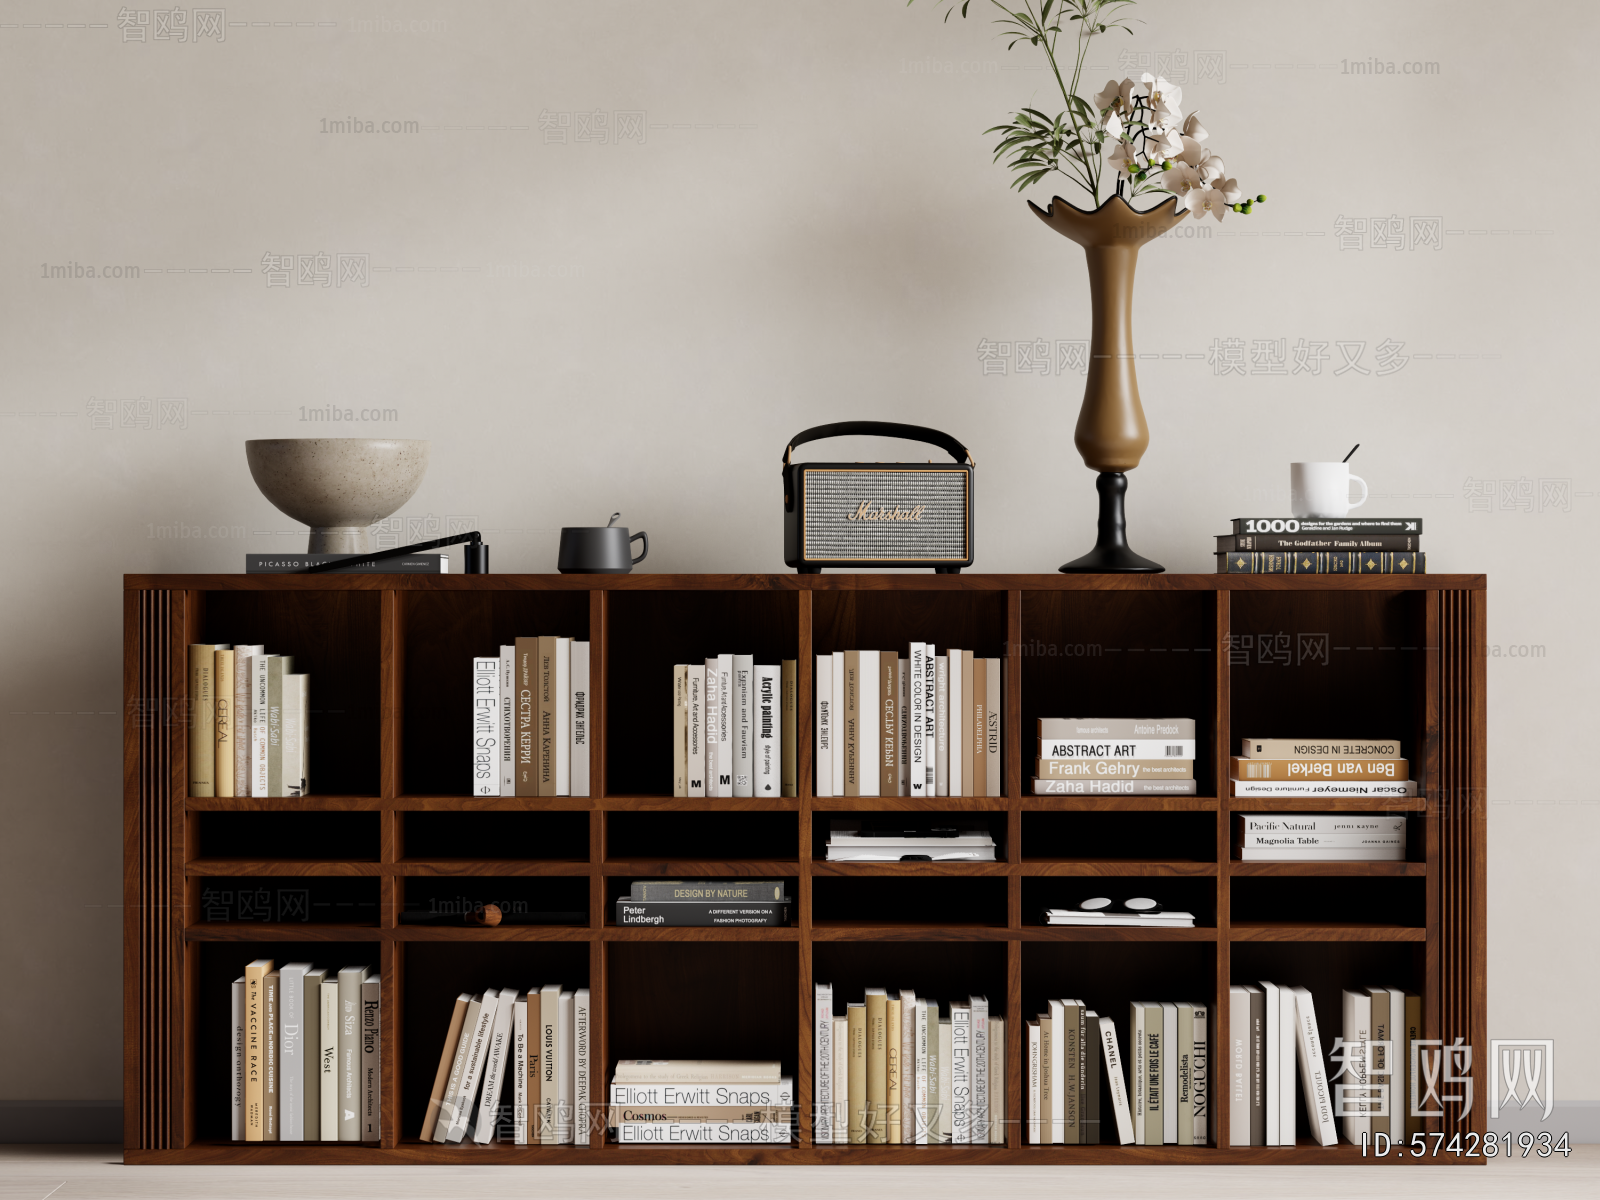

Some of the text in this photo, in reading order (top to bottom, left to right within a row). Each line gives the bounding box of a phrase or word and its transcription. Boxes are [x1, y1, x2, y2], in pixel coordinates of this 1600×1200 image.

[848, 500, 926, 520] Marshall
[1246, 519, 1300, 533] 1000
[707, 668, 717, 744] Zaha Hadid
[926, 656, 934, 738] ABSTRACT ART
[761, 677, 773, 738] Acrylic painting
[218, 699, 228, 748] CEREAL
[270, 706, 280, 746] Wabi-Sabi
[474, 662, 496, 779] Elliott Erwitt Snaps
[520, 690, 531, 764] СЕСТРА КЕРРИ
[575, 692, 585, 744] ФРИДРИХ ЭНГЕЛЬС
[914, 713, 921, 722] IN
[1134, 725, 1179, 735] Antoine Predock
[1052, 745, 1136, 757] ABSTRACT ART
[1294, 746, 1394, 754] CONCRETE IN DESIGN
[1050, 761, 1091, 775] Frank
[1096, 761, 1140, 778] Gehry
[1288, 763, 1394, 776] Ben van Berkel
[720, 775, 730, 785] M
[1045, 780, 1134, 792] Zaha Hadid
[1250, 822, 1316, 831] Pacific Natural
[674, 889, 748, 898] DESIGN BY NATURE
[624, 916, 664, 925] Lindbergh
[345, 1016, 355, 1035] Siza
[364, 1000, 379, 1054] Renzo Piano
[284, 1024, 298, 1055] Dior
[469, 1038, 482, 1074] sustainable
[478, 1013, 489, 1038] lifestyle
[518, 1043, 524, 1053] Be
[1148, 1033, 1159, 1049] CAFÉ
[578, 1006, 586, 1100] AFTERWORD BY DEEPAK
[1105, 1031, 1116, 1069] CHANEL
[324, 1046, 334, 1074] West
[446, 1092, 454, 1106] THIS
[454, 1055, 464, 1075] GOOD
[460, 1033, 469, 1054] GUIDE
[530, 1054, 538, 1078] Paris
[952, 1012, 969, 1127] Elliott Erwitt Snaps
[1150, 1059, 1159, 1072] FOIS
[485, 1033, 503, 1107] DREAM AWAKE
[889, 1048, 897, 1096] CEREAL
[1150, 1074, 1159, 1085] UNE
[1180, 1054, 1188, 1103] Remodelista
[1194, 1041, 1206, 1117] NOGUCHI
[616, 1088, 769, 1106] Elliott Erwitt Snaps
[1148, 1087, 1159, 1103] ÉTAIT
[344, 1109, 355, 1120] A
[623, 1110, 667, 1121] Cosmos
[623, 1125, 769, 1143] Elliott Erwitt Snaps
